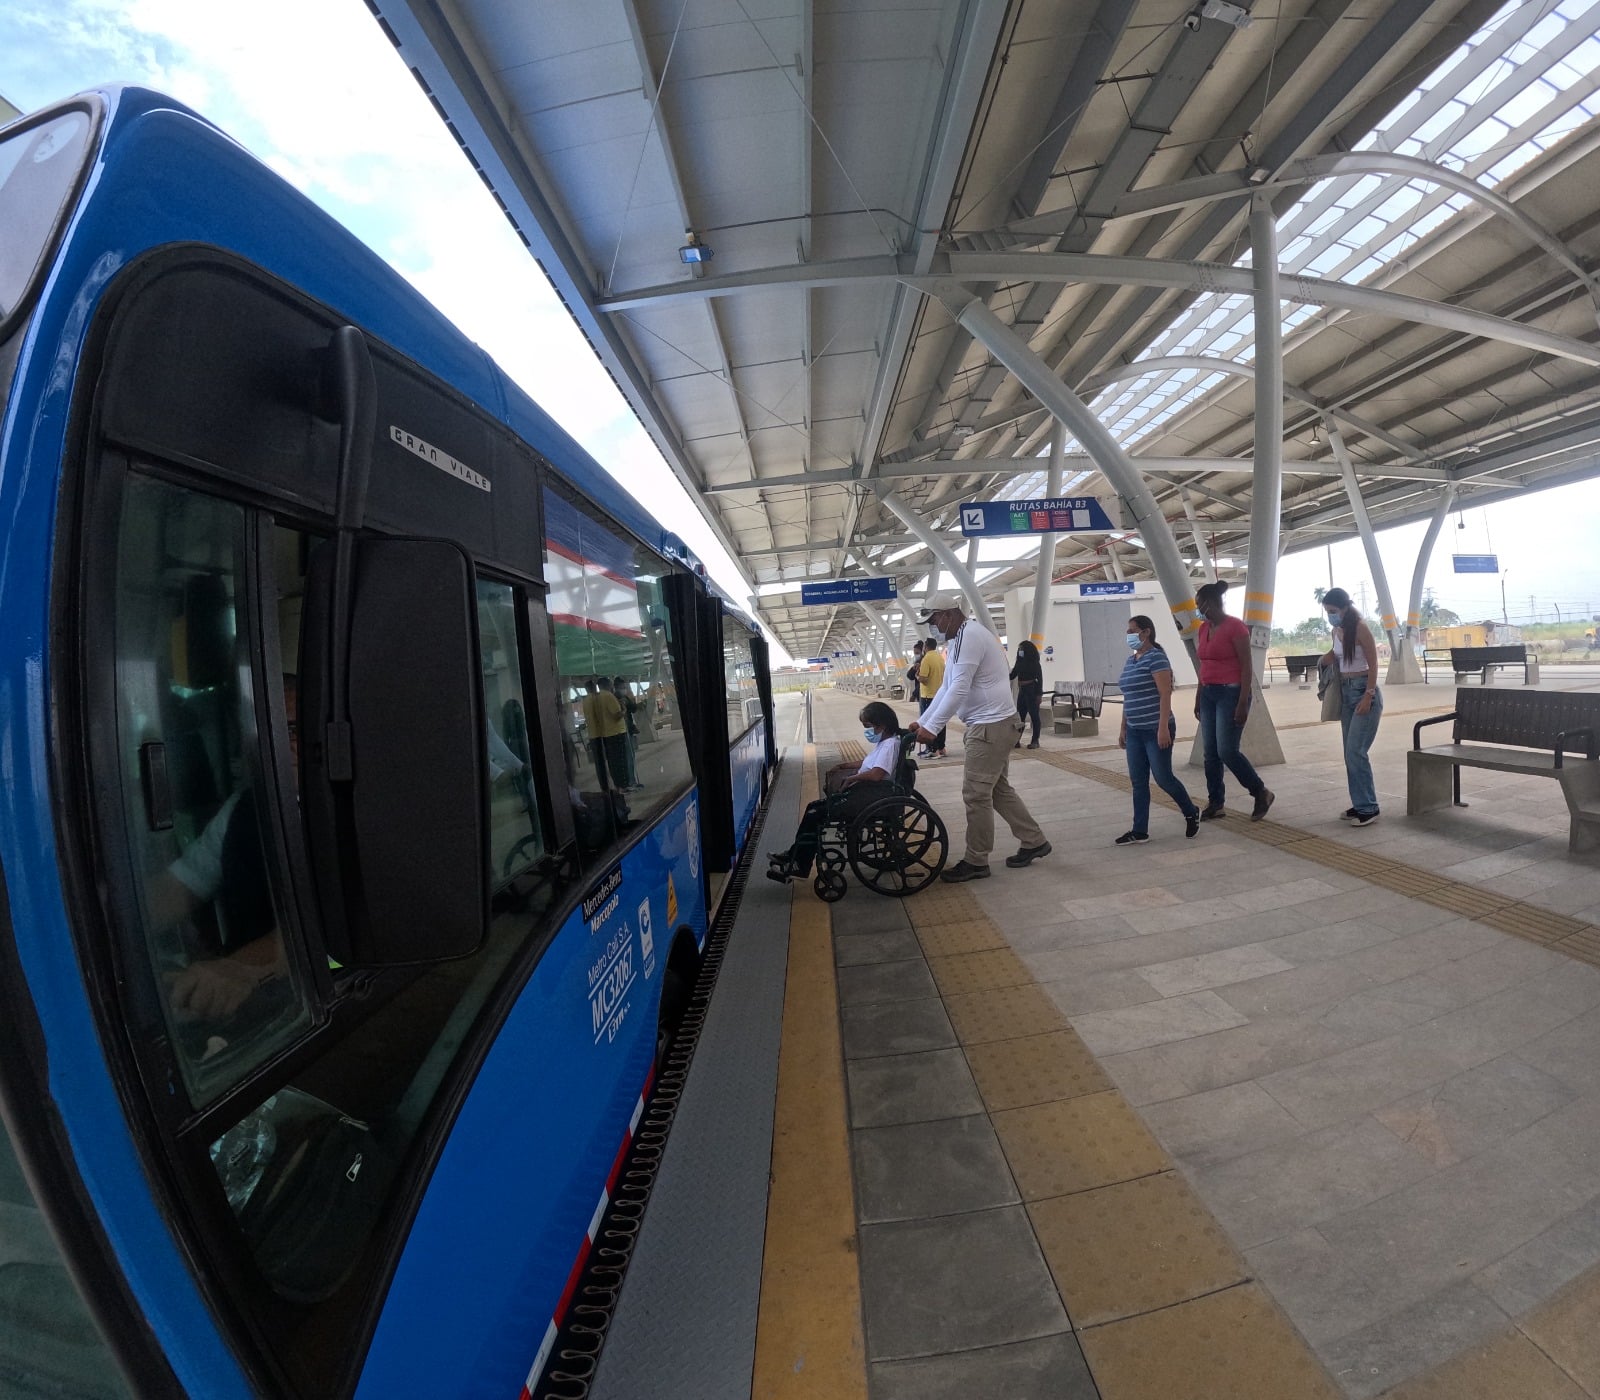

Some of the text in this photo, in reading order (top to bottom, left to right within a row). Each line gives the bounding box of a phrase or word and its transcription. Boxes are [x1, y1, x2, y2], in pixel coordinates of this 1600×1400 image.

[394, 428, 487, 489] GRAN VIALE
[1009, 502, 1041, 511] RUTAS
[1075, 500, 1087, 509] B3
[583, 870, 622, 920] Mercedes-Benz
[587, 955, 607, 988] Metro
[606, 932, 619, 960] Cali
[591, 943, 632, 1036] MC32067
